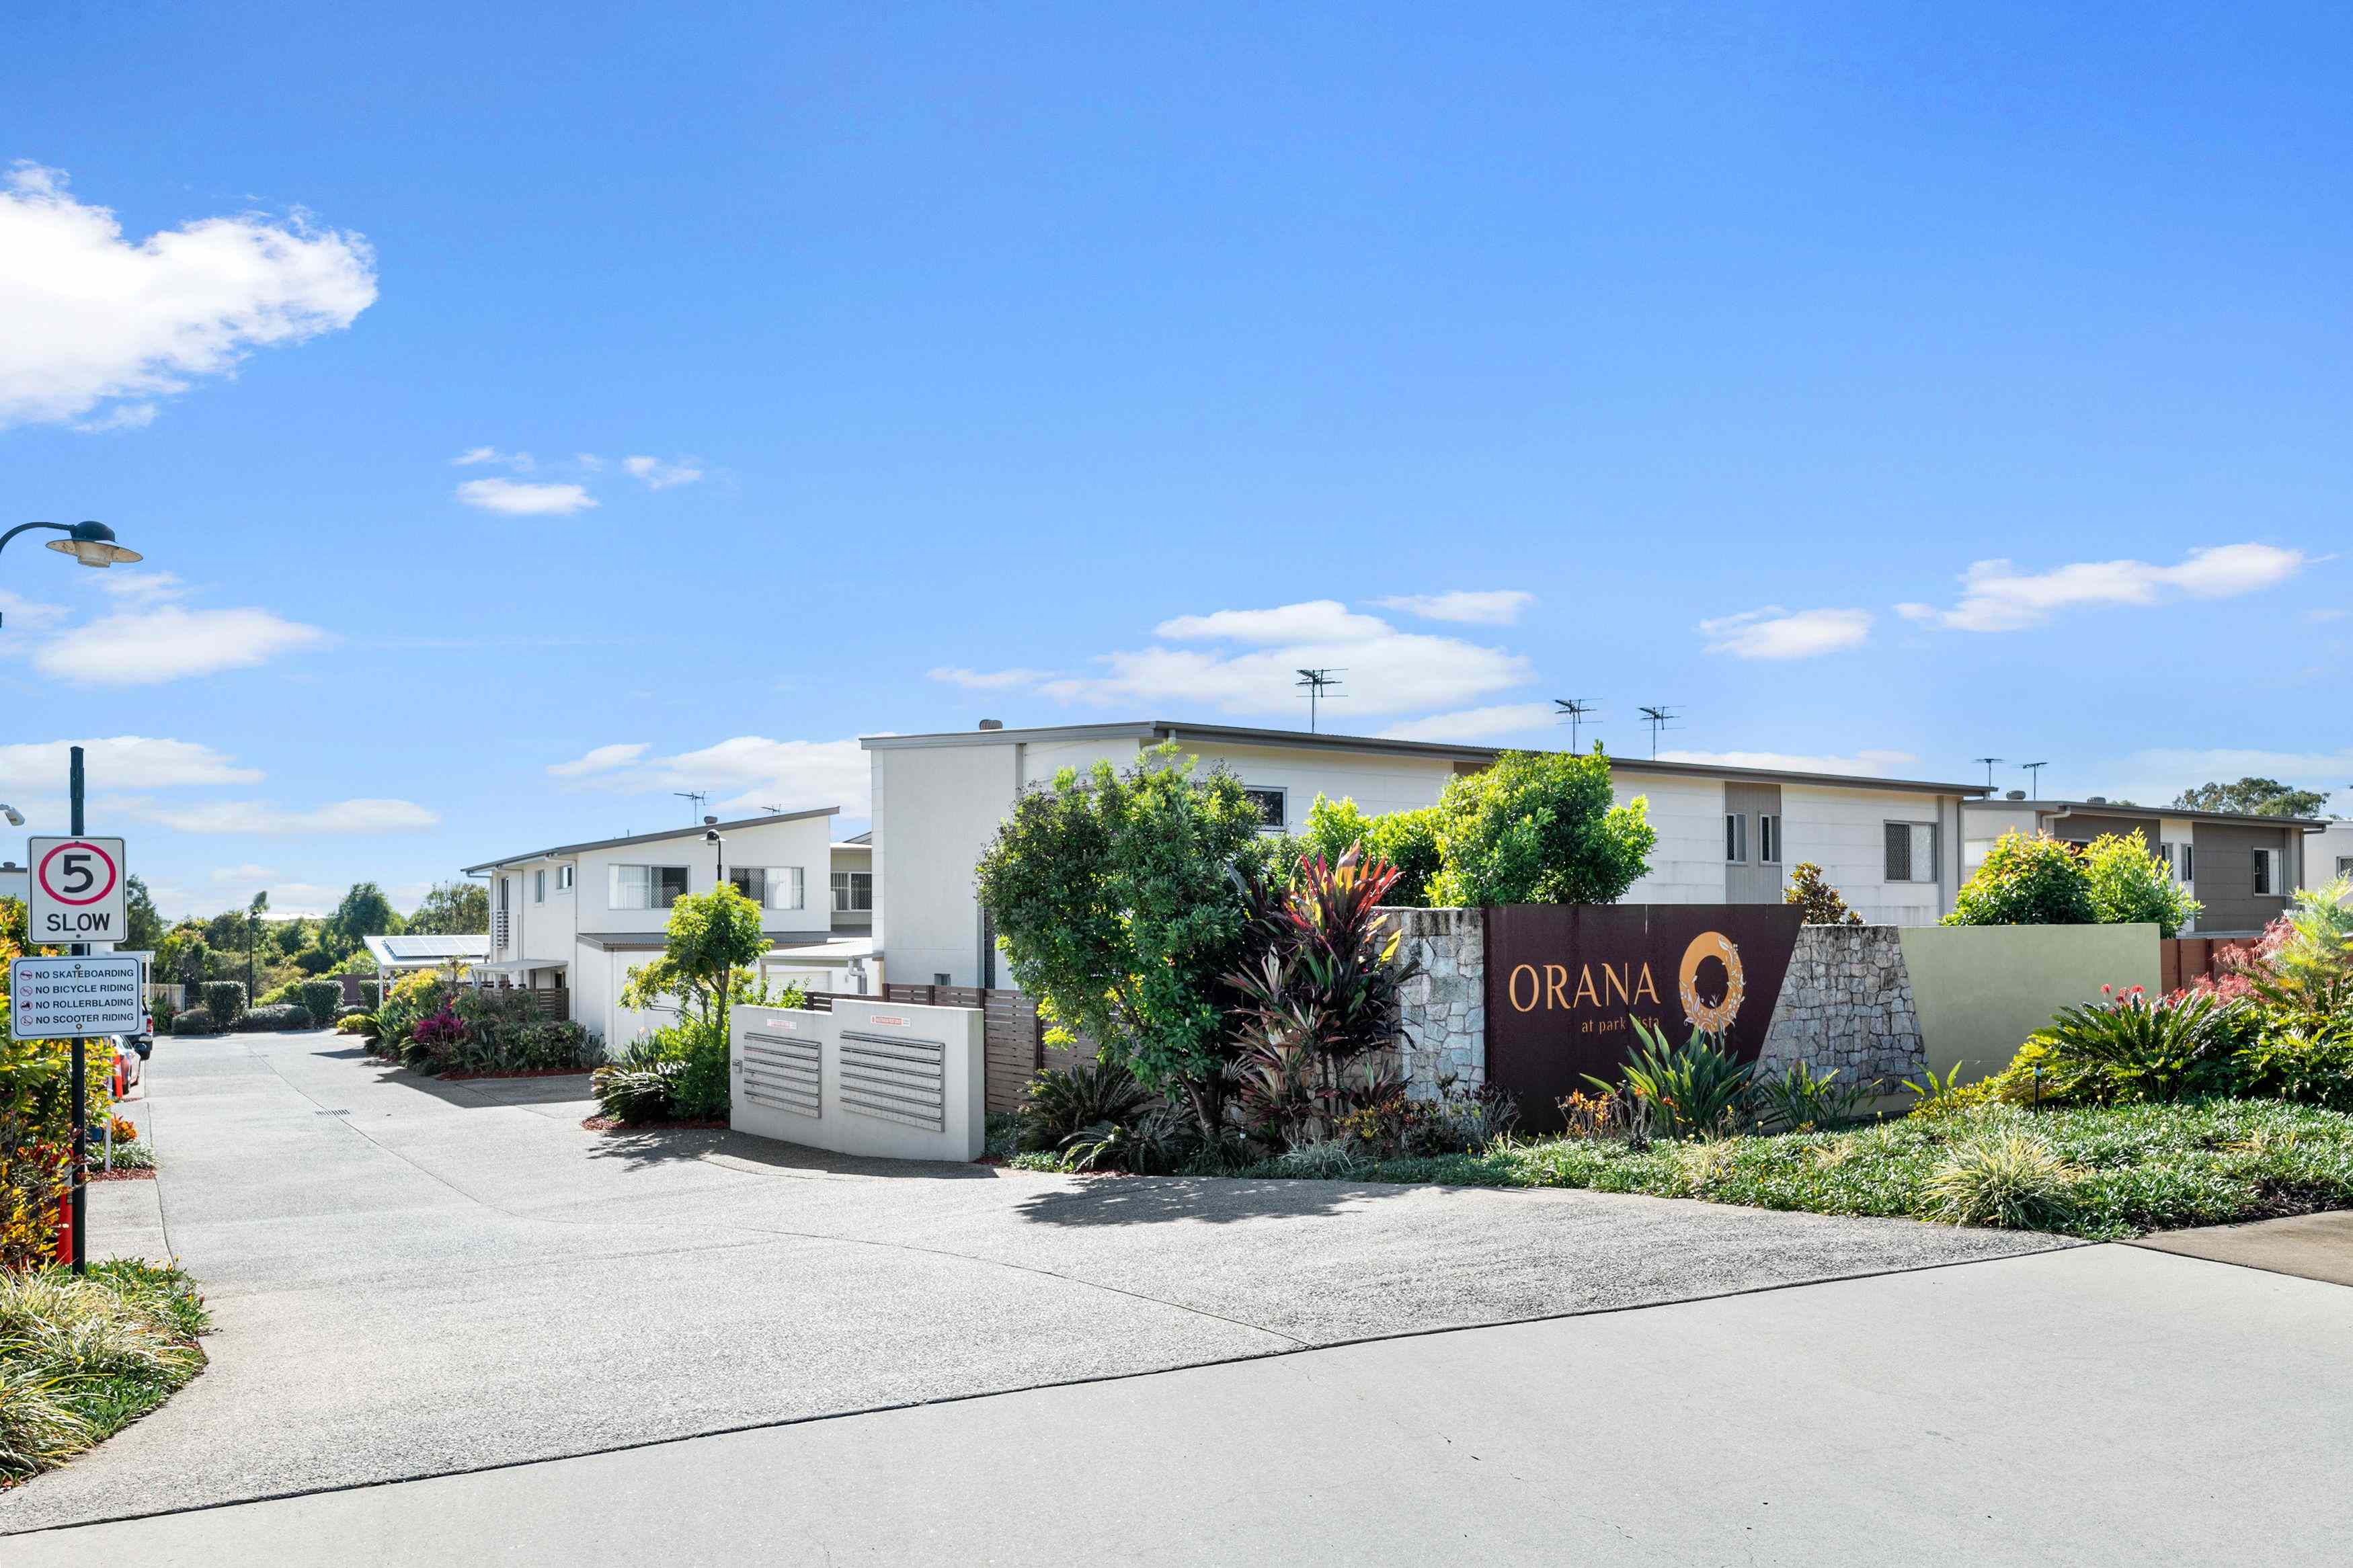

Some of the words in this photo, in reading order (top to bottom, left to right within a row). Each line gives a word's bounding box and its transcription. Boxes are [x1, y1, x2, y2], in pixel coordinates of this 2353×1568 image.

[63, 854, 94, 893] 5
[46, 913, 110, 932] SLOW
[35, 971, 50, 979] NO
[52, 969, 134, 979] SKATEBOARDING
[36, 986, 50, 994] NO
[52, 985, 97, 993] BICYCLE
[100, 984, 134, 992] RIDING
[1509, 962, 1661, 1012] ORANA
[36, 1001, 50, 1009] NO
[52, 998, 134, 1008] ROLLERBLADING
[36, 1016, 50, 1024] NO
[52, 1014, 99, 1024] SCOOTER
[102, 1013, 134, 1022] RIDING
[1581, 1019, 1593, 1033] at
[1599, 1016, 1626, 1035] park
[1637, 1016, 1660, 1029] sta
